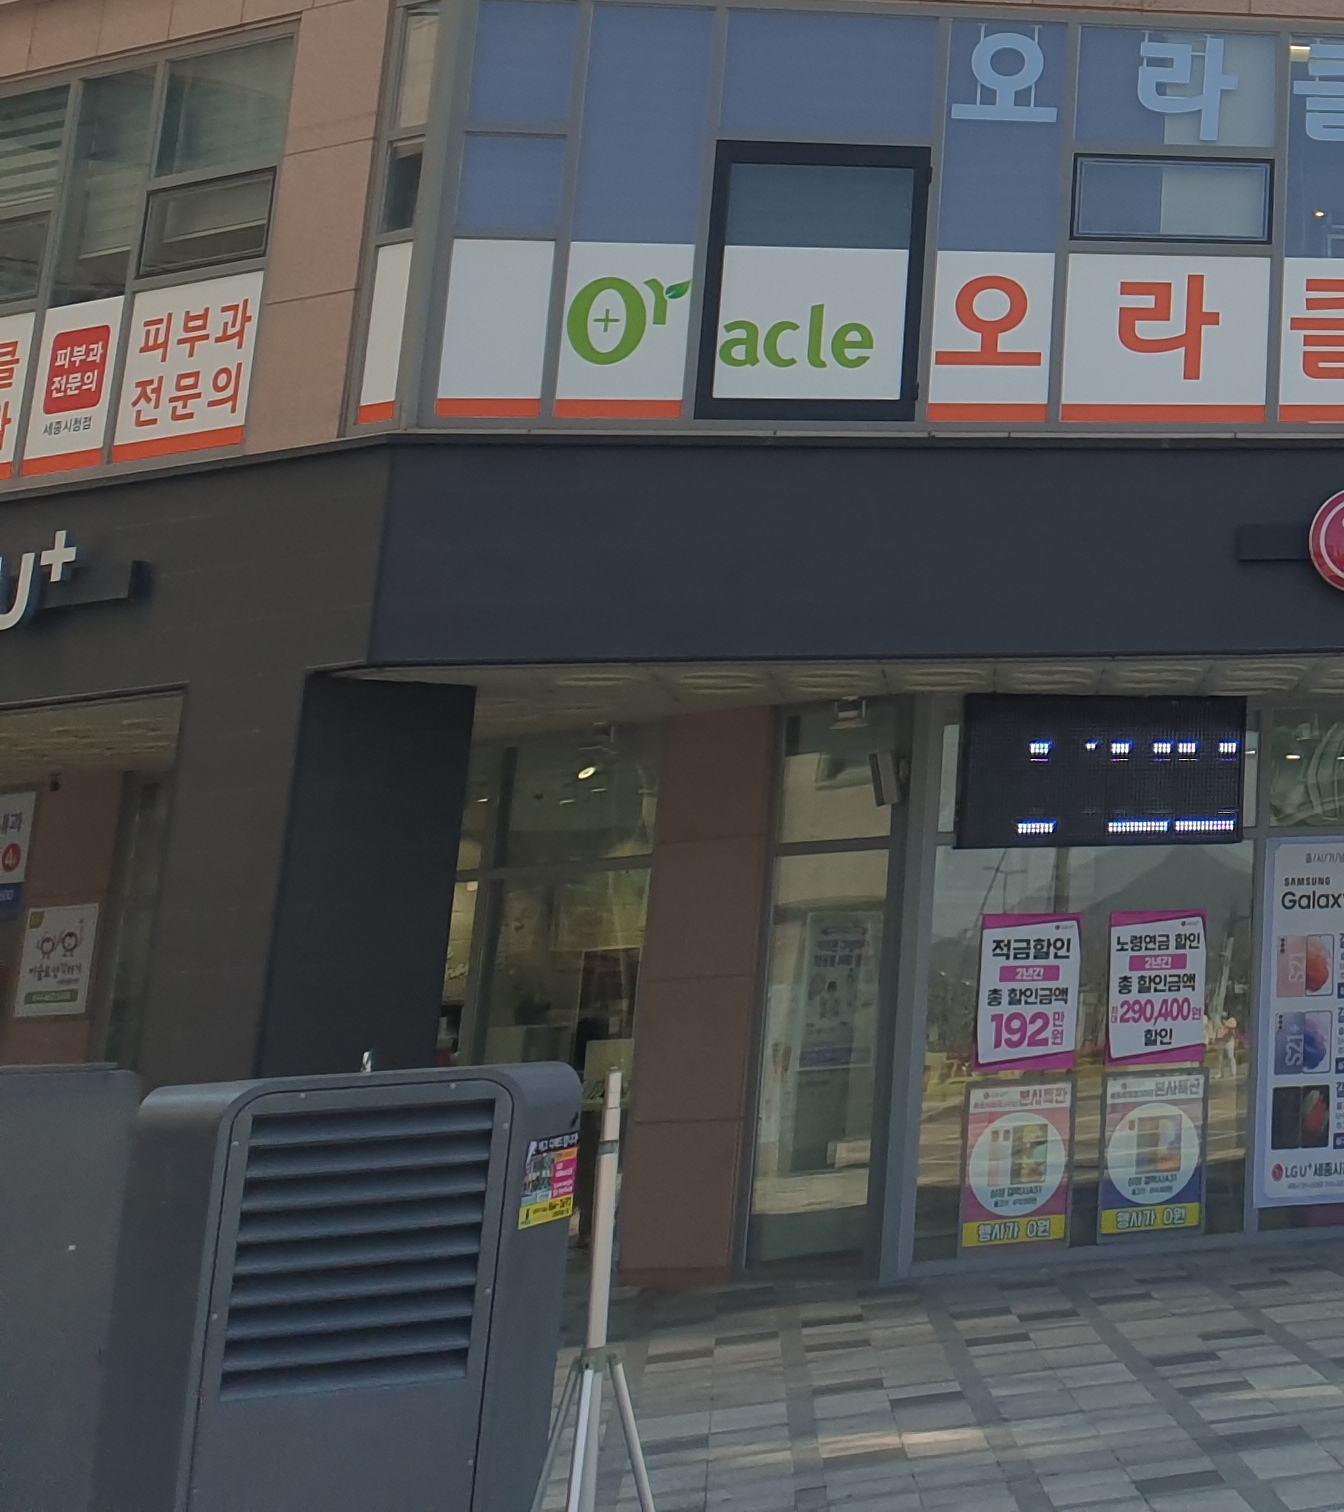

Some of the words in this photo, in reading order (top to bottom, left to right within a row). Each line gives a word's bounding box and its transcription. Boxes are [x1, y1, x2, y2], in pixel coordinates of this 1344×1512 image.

[138, 299, 252, 364] 피부과
[55, 340, 104, 370] 피부과
[50, 369, 99, 399] 전문의
[131, 362, 241, 429] 전문의
[42, 414, 93, 438] 세종시청점
[1284, 876, 1331, 887] SAMSUNG
[991, 937, 1071, 960] 적금할인
[1115, 933, 1171, 953] 노령연금
[1174, 932, 1202, 951] 할인
[986, 987, 1003, 1007] 총
[1008, 986, 1070, 1006] 할인금액
[1117, 976, 1133, 996] 총
[1136, 973, 1197, 994] 할인금액
[991, 1012, 1050, 1049] 192
[1144, 1028, 1174, 1046] 할인
[1115, 1208, 1158, 1231] 행사가
[1163, 1206, 1187, 1226] 0원
[976, 1220, 1020, 1244] 행사가
[1026, 1219, 1051, 1239] 0원
